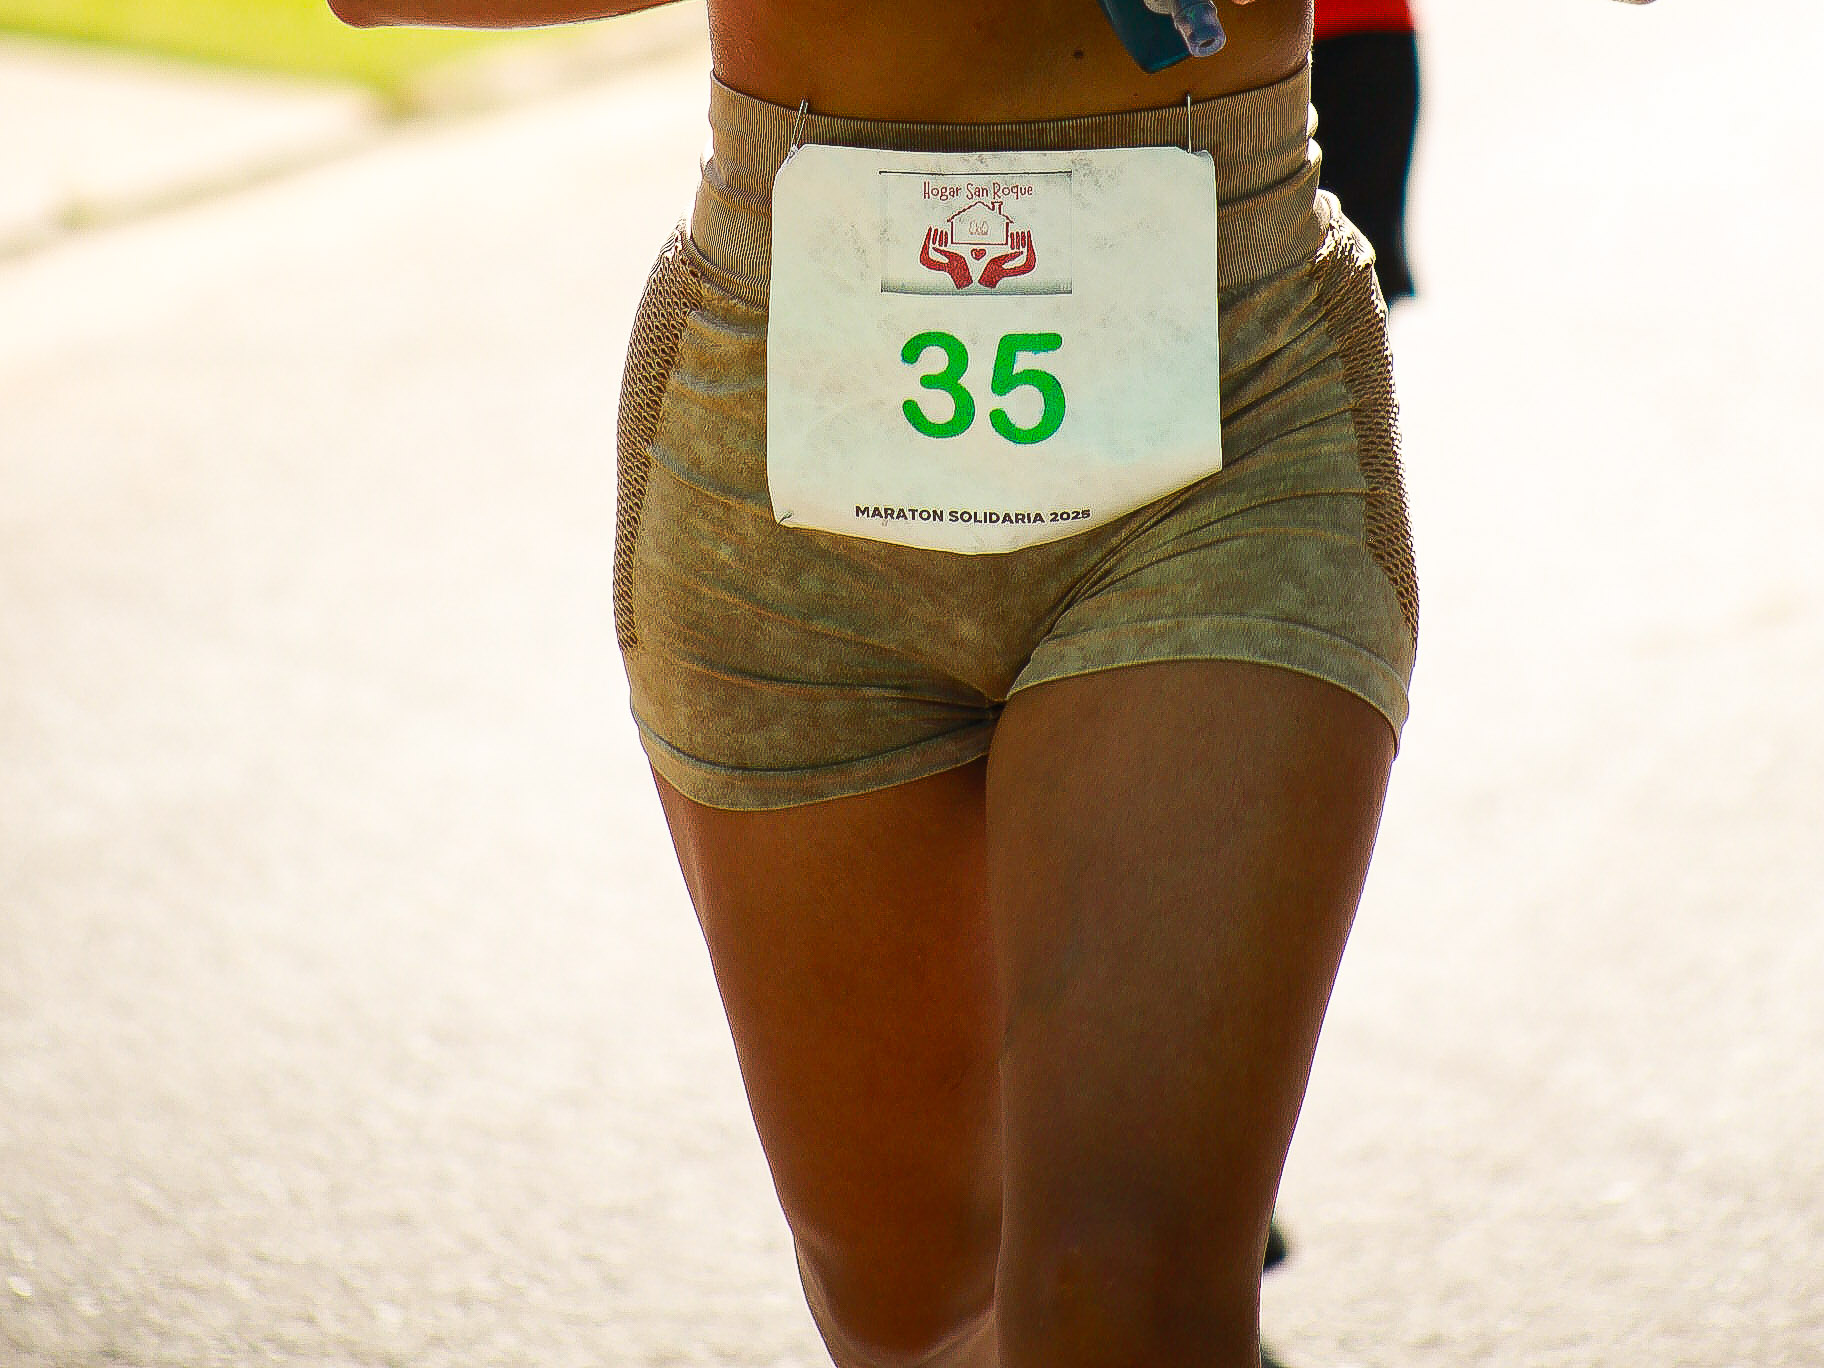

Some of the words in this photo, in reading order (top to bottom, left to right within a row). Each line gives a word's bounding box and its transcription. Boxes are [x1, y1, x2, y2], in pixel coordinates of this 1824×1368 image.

[923, 181, 961, 201] Hogar
[966, 183, 989, 200] San
[993, 182, 1033, 200] Roque
[900, 331, 1066, 445] 35
[855, 505, 944, 523] MARATON
[948, 510, 1046, 525] SOLIDARIA
[1049, 508, 1092, 523] 2025
